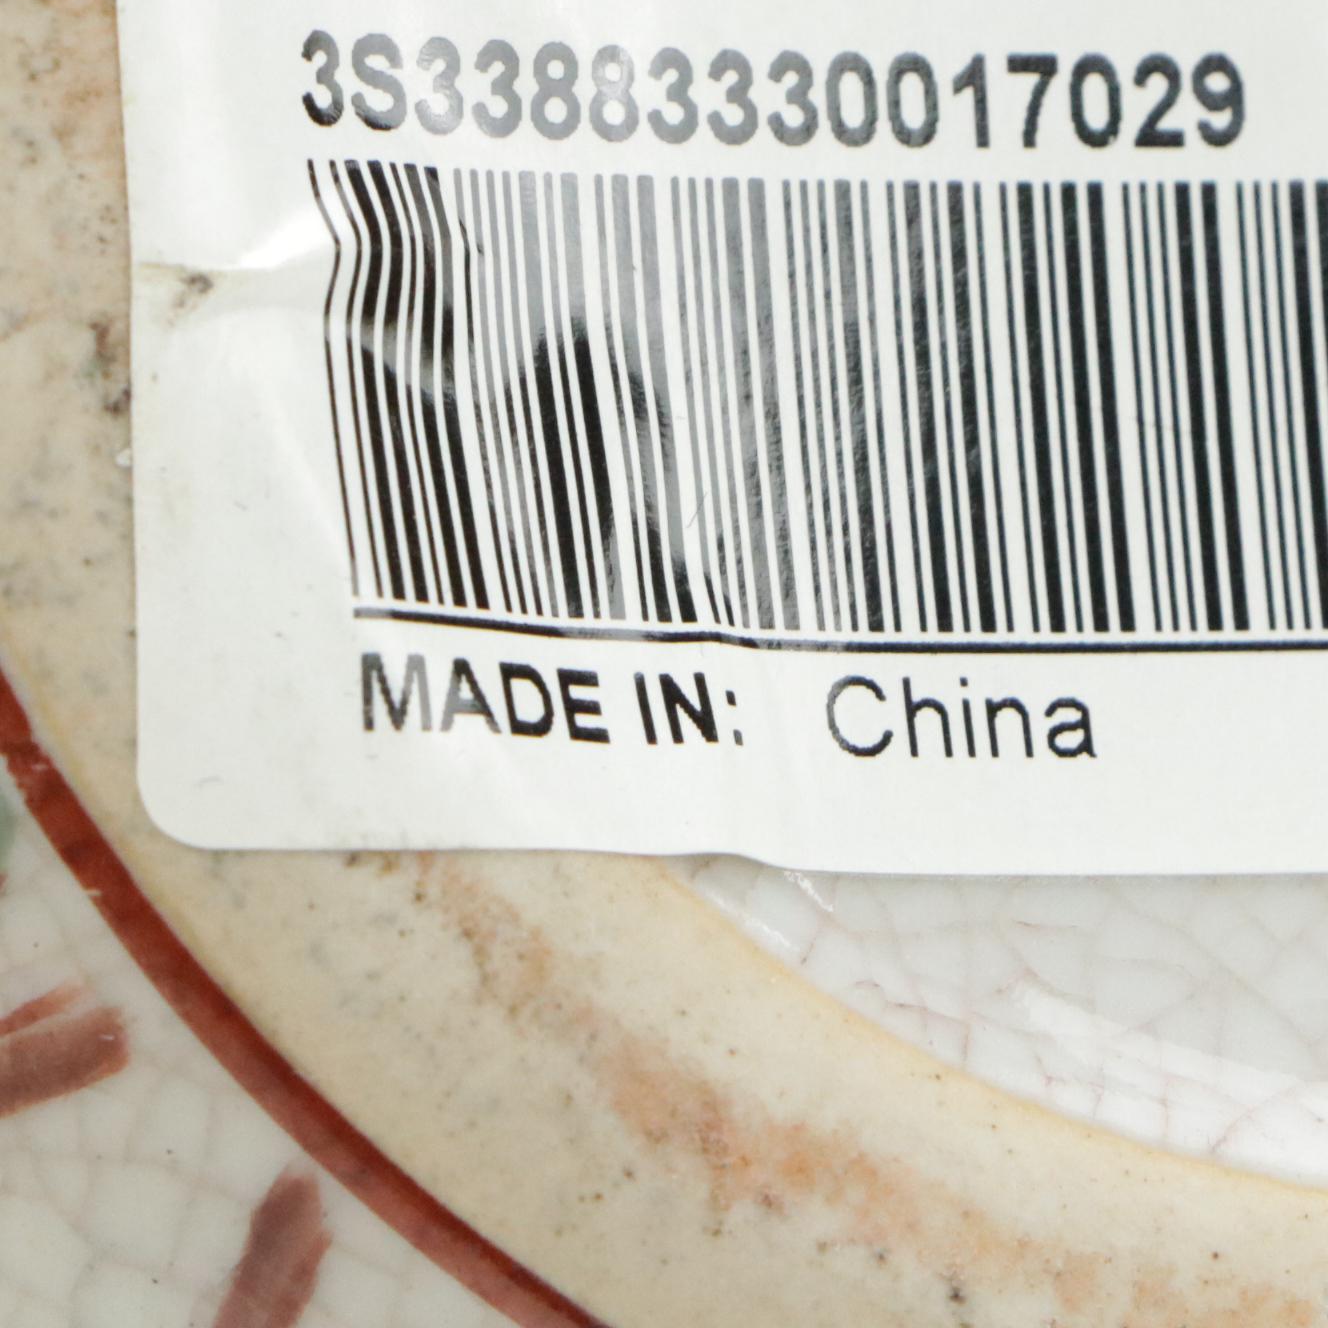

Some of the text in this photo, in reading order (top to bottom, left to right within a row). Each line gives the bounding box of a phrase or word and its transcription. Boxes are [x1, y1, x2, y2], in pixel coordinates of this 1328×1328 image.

[301, 29, 1246, 148] 3S33883330017029
[360, 652, 1098, 759] MADE IN: China
